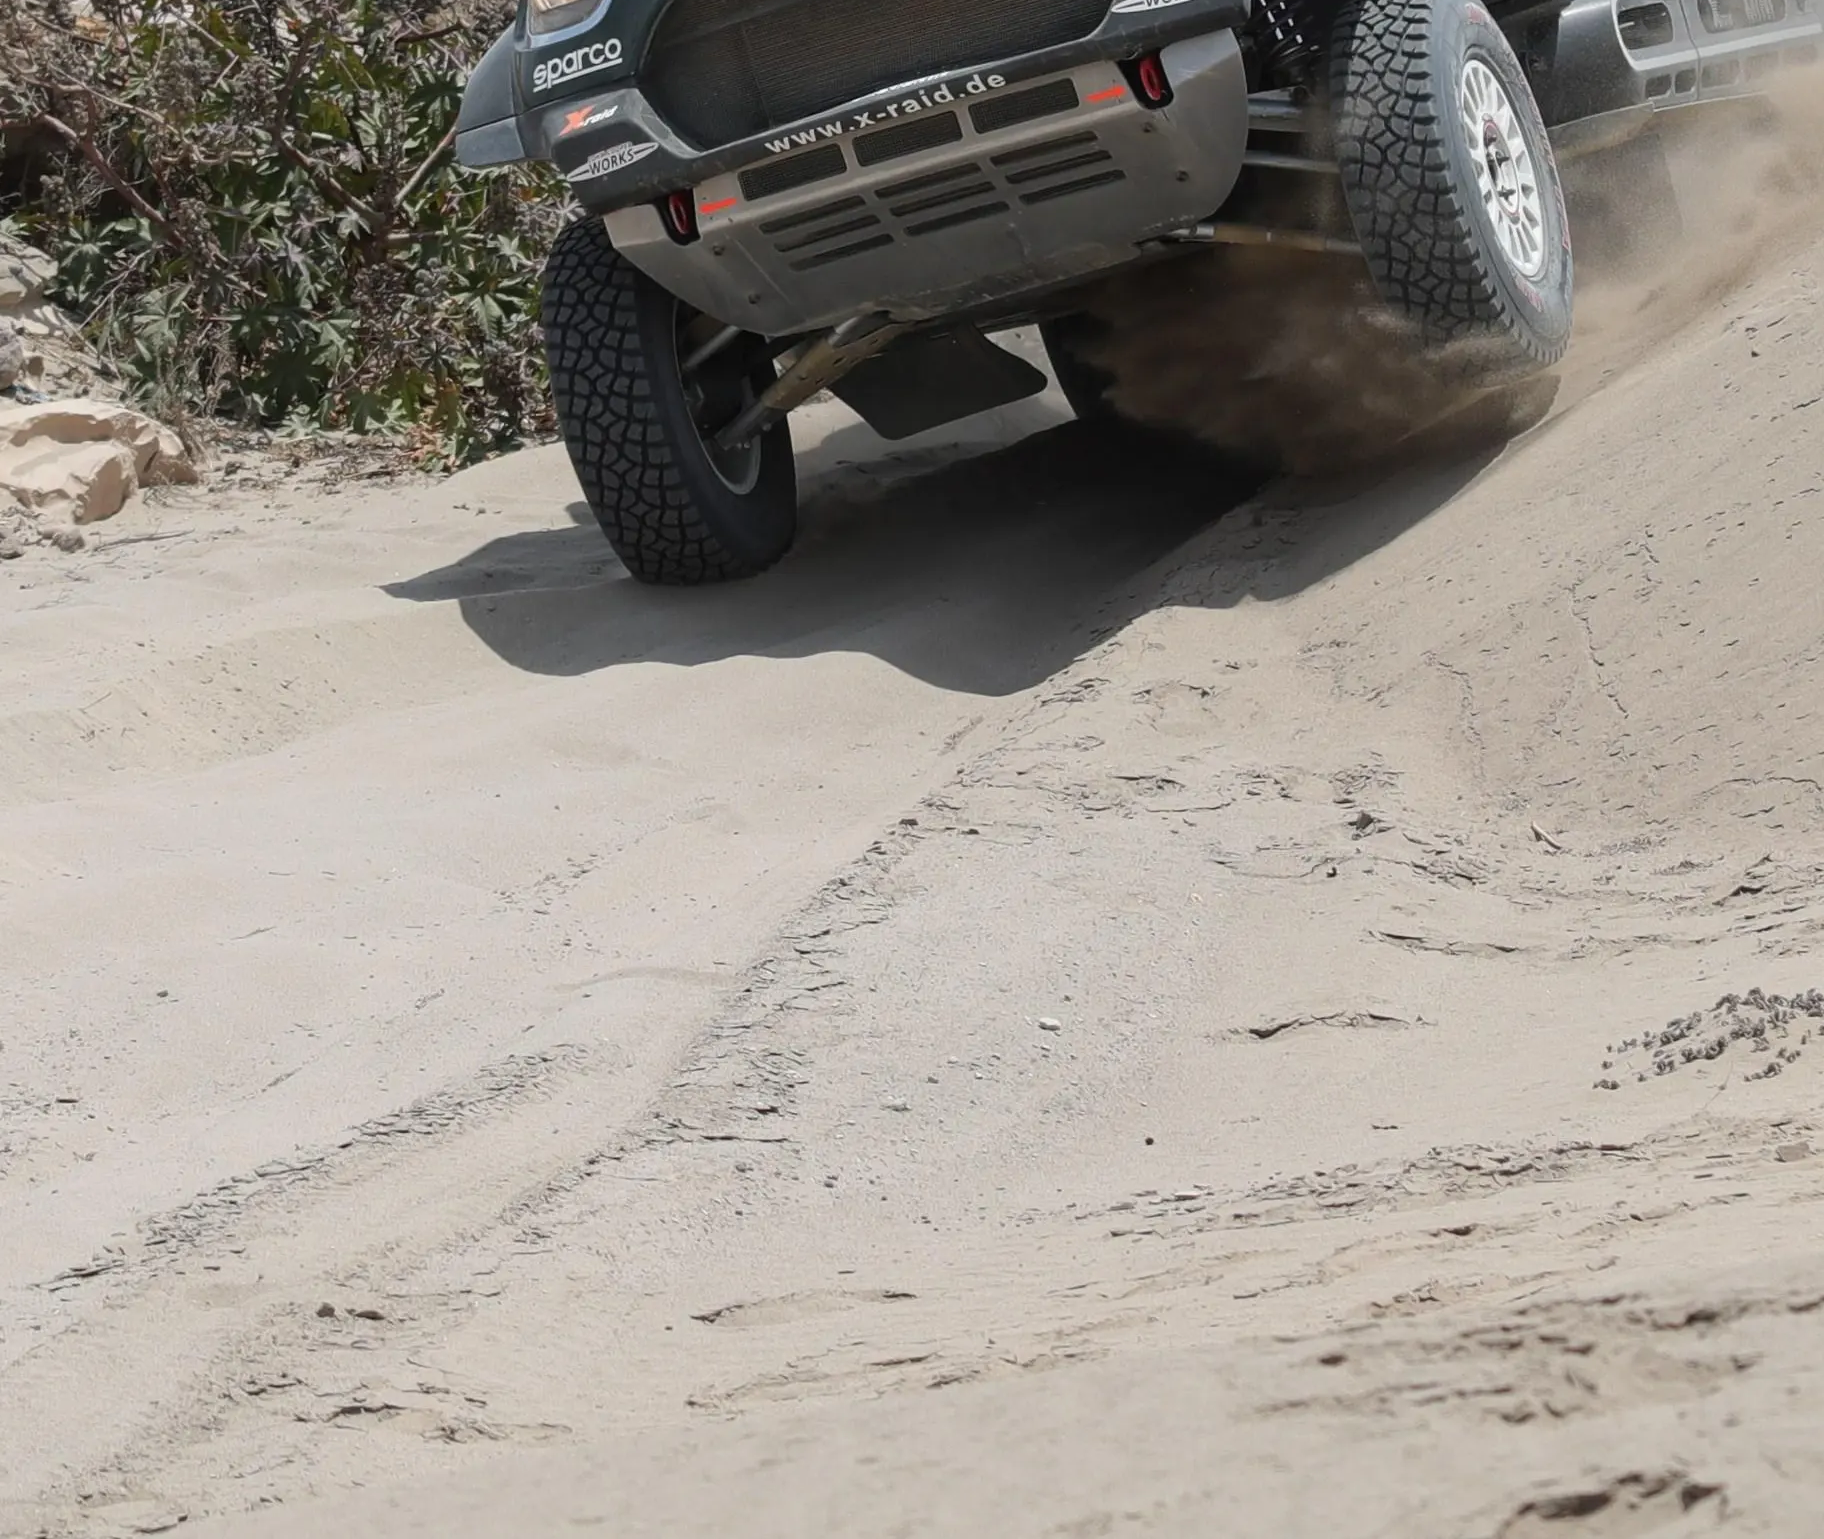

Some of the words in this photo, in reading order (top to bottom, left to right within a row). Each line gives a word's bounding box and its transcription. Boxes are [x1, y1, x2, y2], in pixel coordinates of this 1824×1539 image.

[533, 38, 623, 93] sparco
[764, 74, 1006, 154] www.x-raid.de
[589, 148, 635, 176] WORKS
